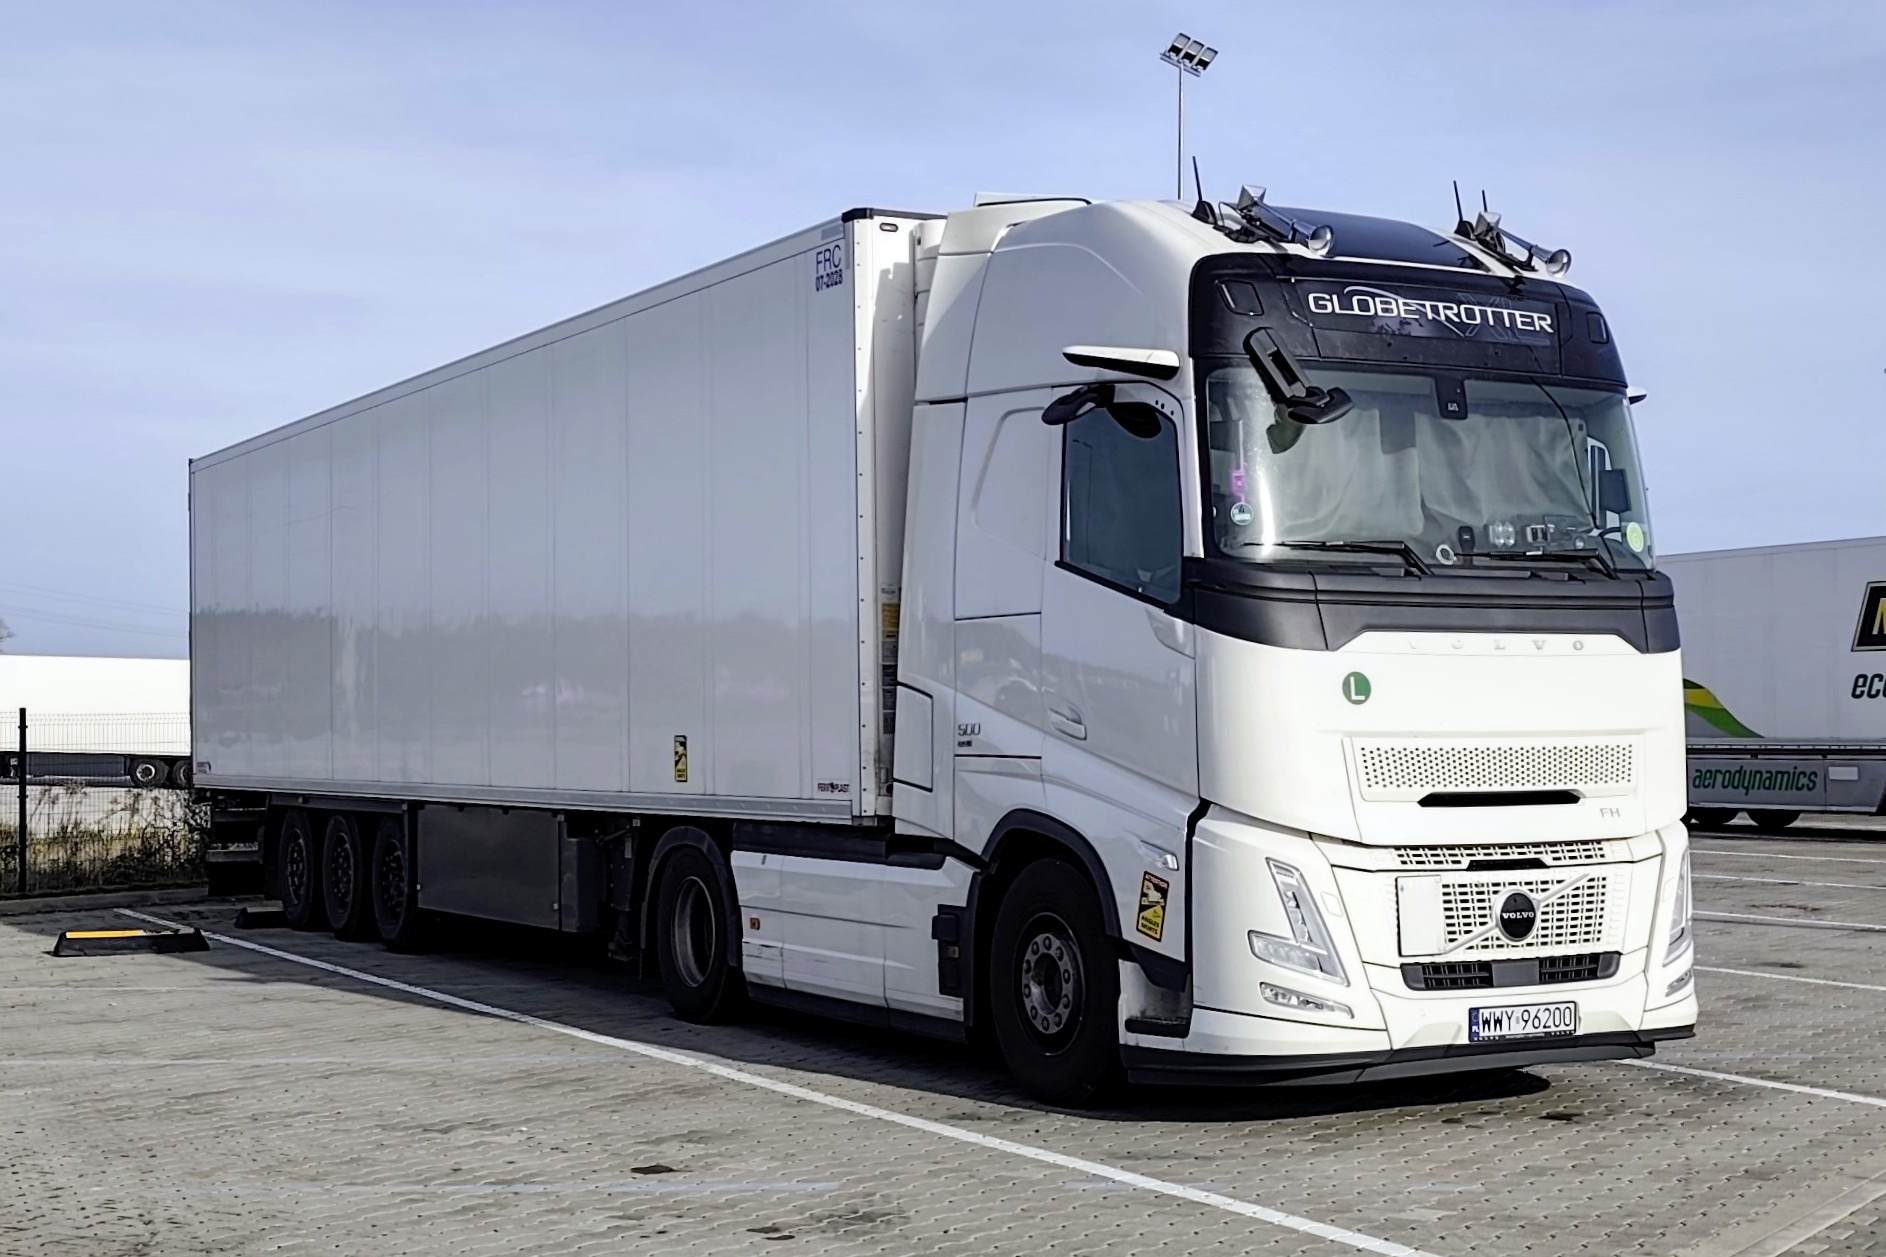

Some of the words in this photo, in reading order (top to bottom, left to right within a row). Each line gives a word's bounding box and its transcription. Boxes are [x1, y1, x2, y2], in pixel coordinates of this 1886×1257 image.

[816, 244, 842, 275] FRC
[1308, 293, 1554, 333] GLOBETROTTER
[1349, 676, 1366, 700] L
[1851, 673, 1886, 699] ec
[958, 722, 981, 736] 500
[1692, 765, 1818, 796] aerodynamics
[1600, 807, 1621, 818] FH
[1502, 911, 1535, 919] VOLVO
[1481, 1010, 1515, 1033] WWY
[1521, 1006, 1572, 1031] 96200
